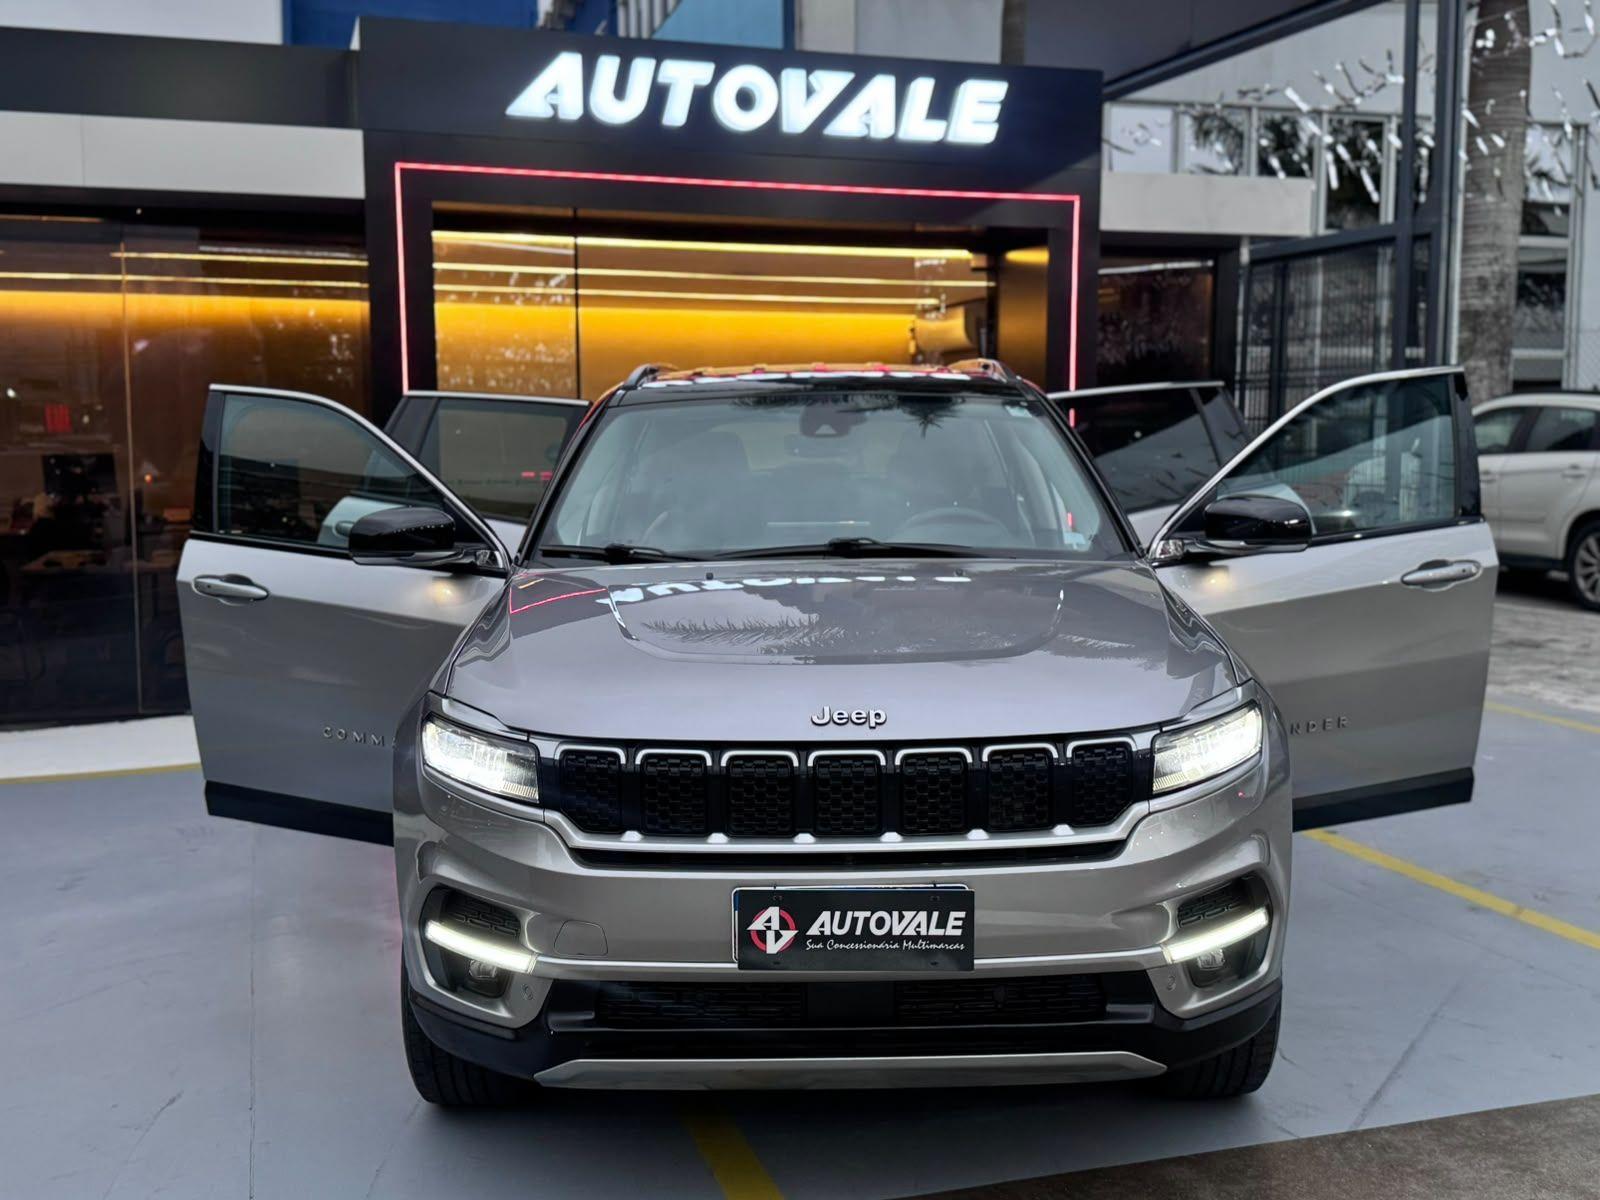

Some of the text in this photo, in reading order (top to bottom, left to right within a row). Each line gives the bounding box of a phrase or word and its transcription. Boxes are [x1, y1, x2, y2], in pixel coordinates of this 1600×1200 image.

[505, 50, 1009, 145] AUTOVALE
[811, 706, 887, 729] Jeep
[323, 726, 396, 748] COMM
[806, 911, 966, 936] AUTOVALE
[806, 939, 824, 950] Sua
[902, 939, 965, 950] Multimarcas
